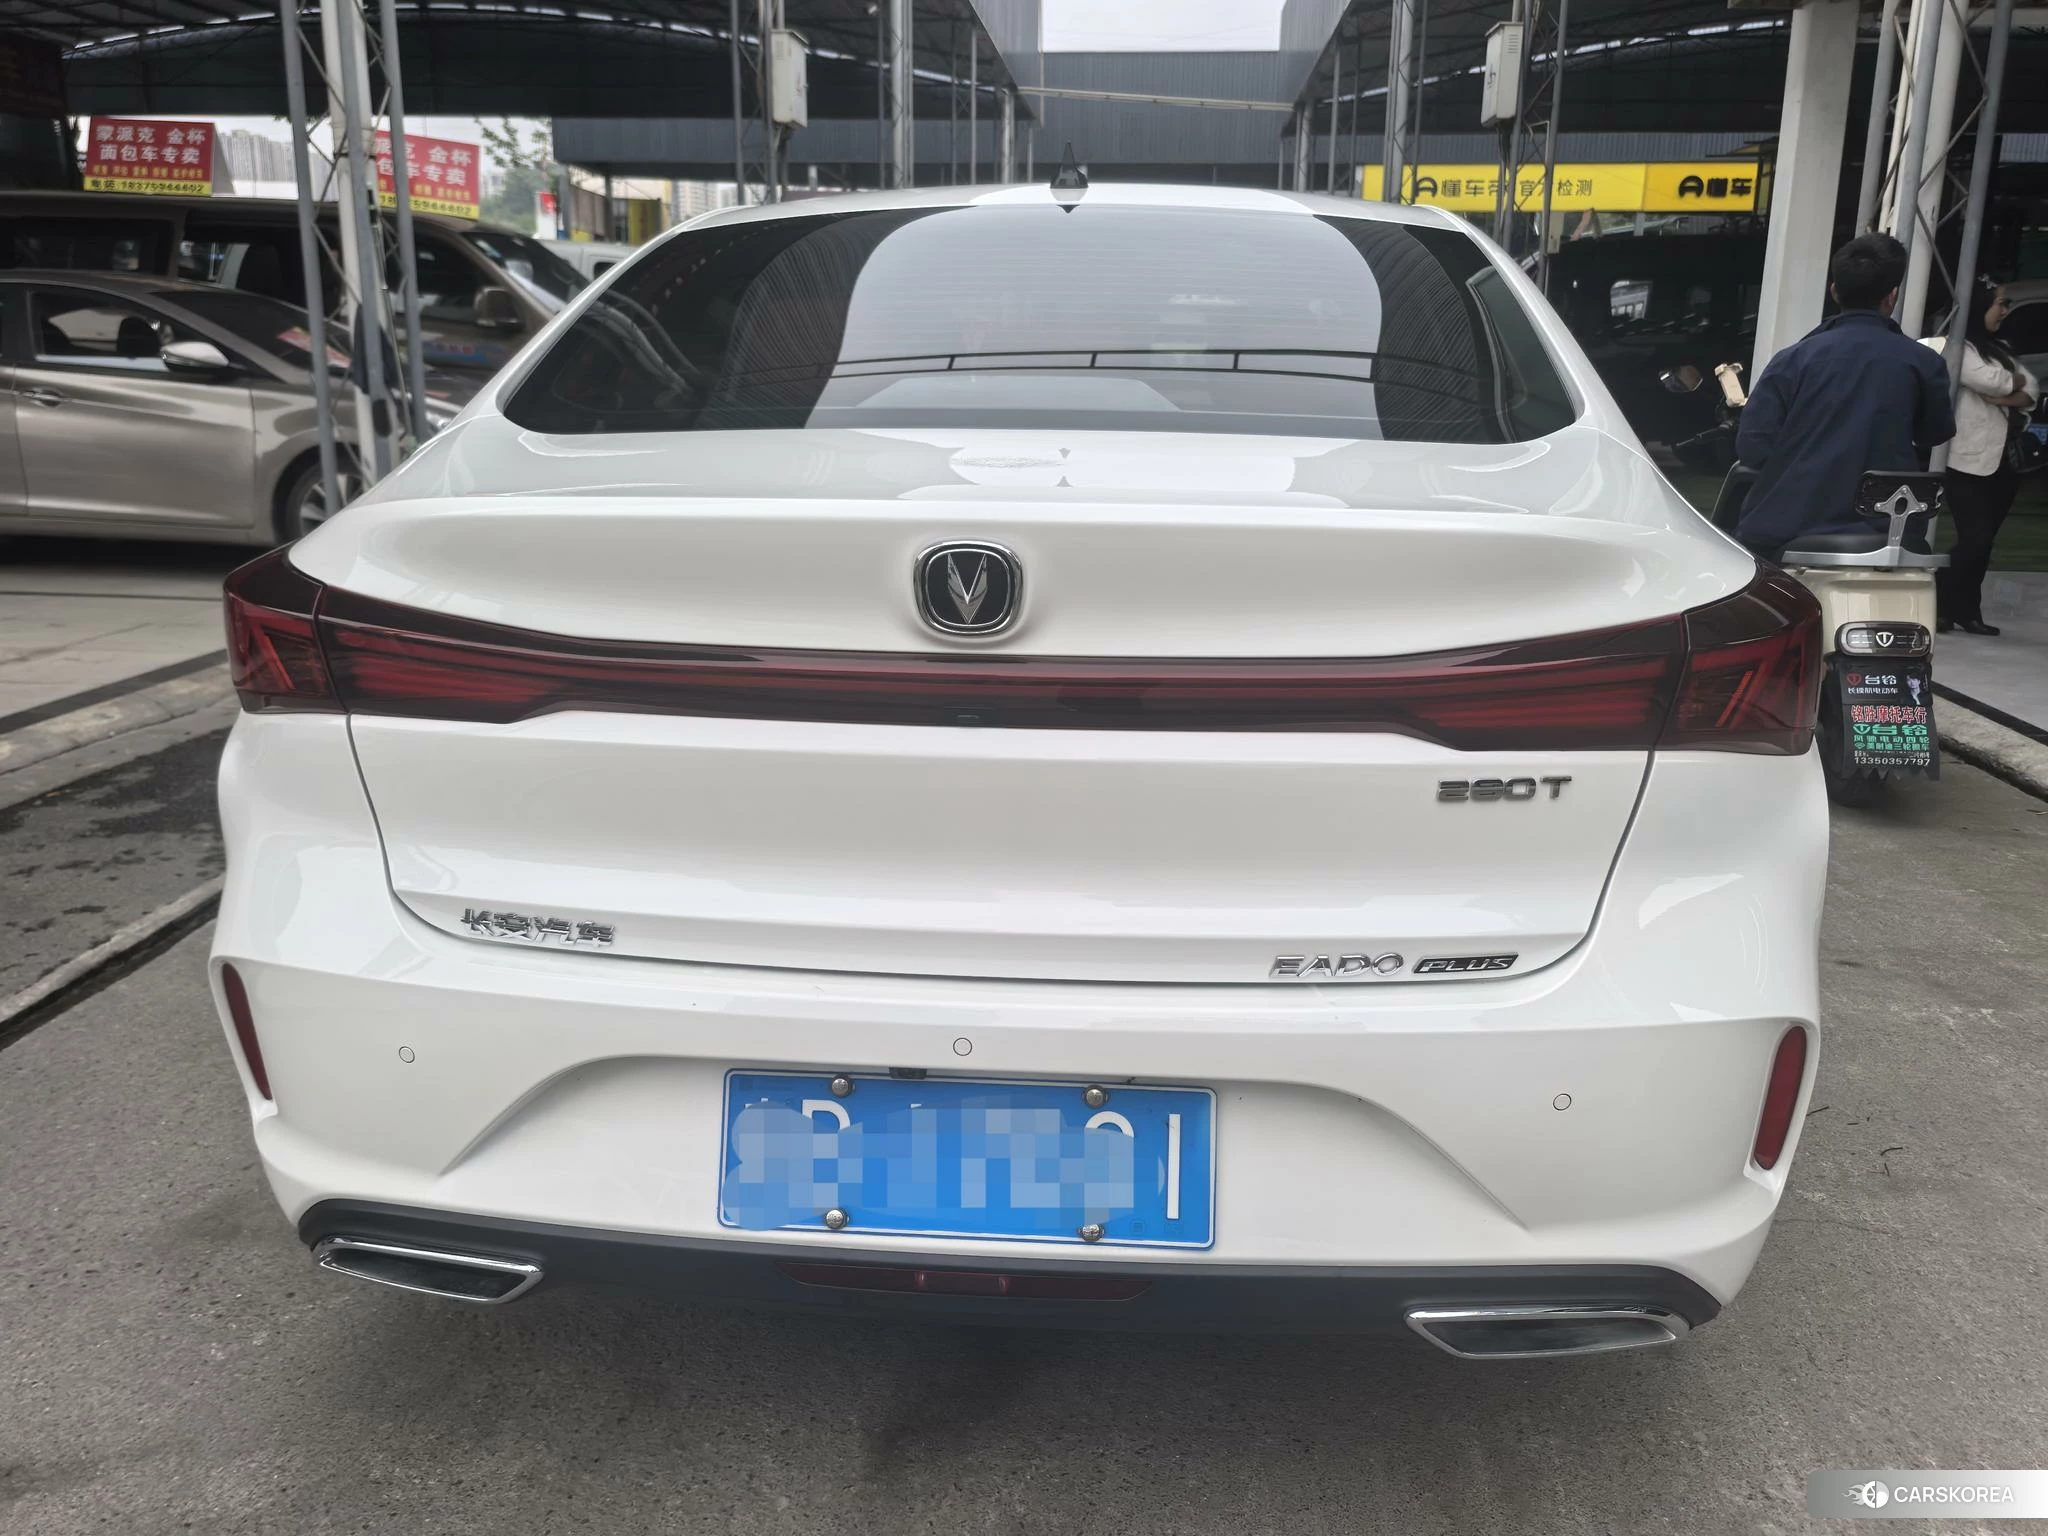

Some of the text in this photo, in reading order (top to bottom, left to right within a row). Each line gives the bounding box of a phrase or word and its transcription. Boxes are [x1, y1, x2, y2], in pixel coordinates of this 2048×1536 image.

[168, 128, 207, 145] 金杯
[100, 144, 200, 164] 面包车专卖
[428, 146, 472, 166] 金杯
[1865, 675, 1897, 685] 台铃
[1872, 724, 1928, 736] 台铃
[1855, 758, 1930, 766] 13350357797
[1268, 953, 1516, 977] EADO PLUS
